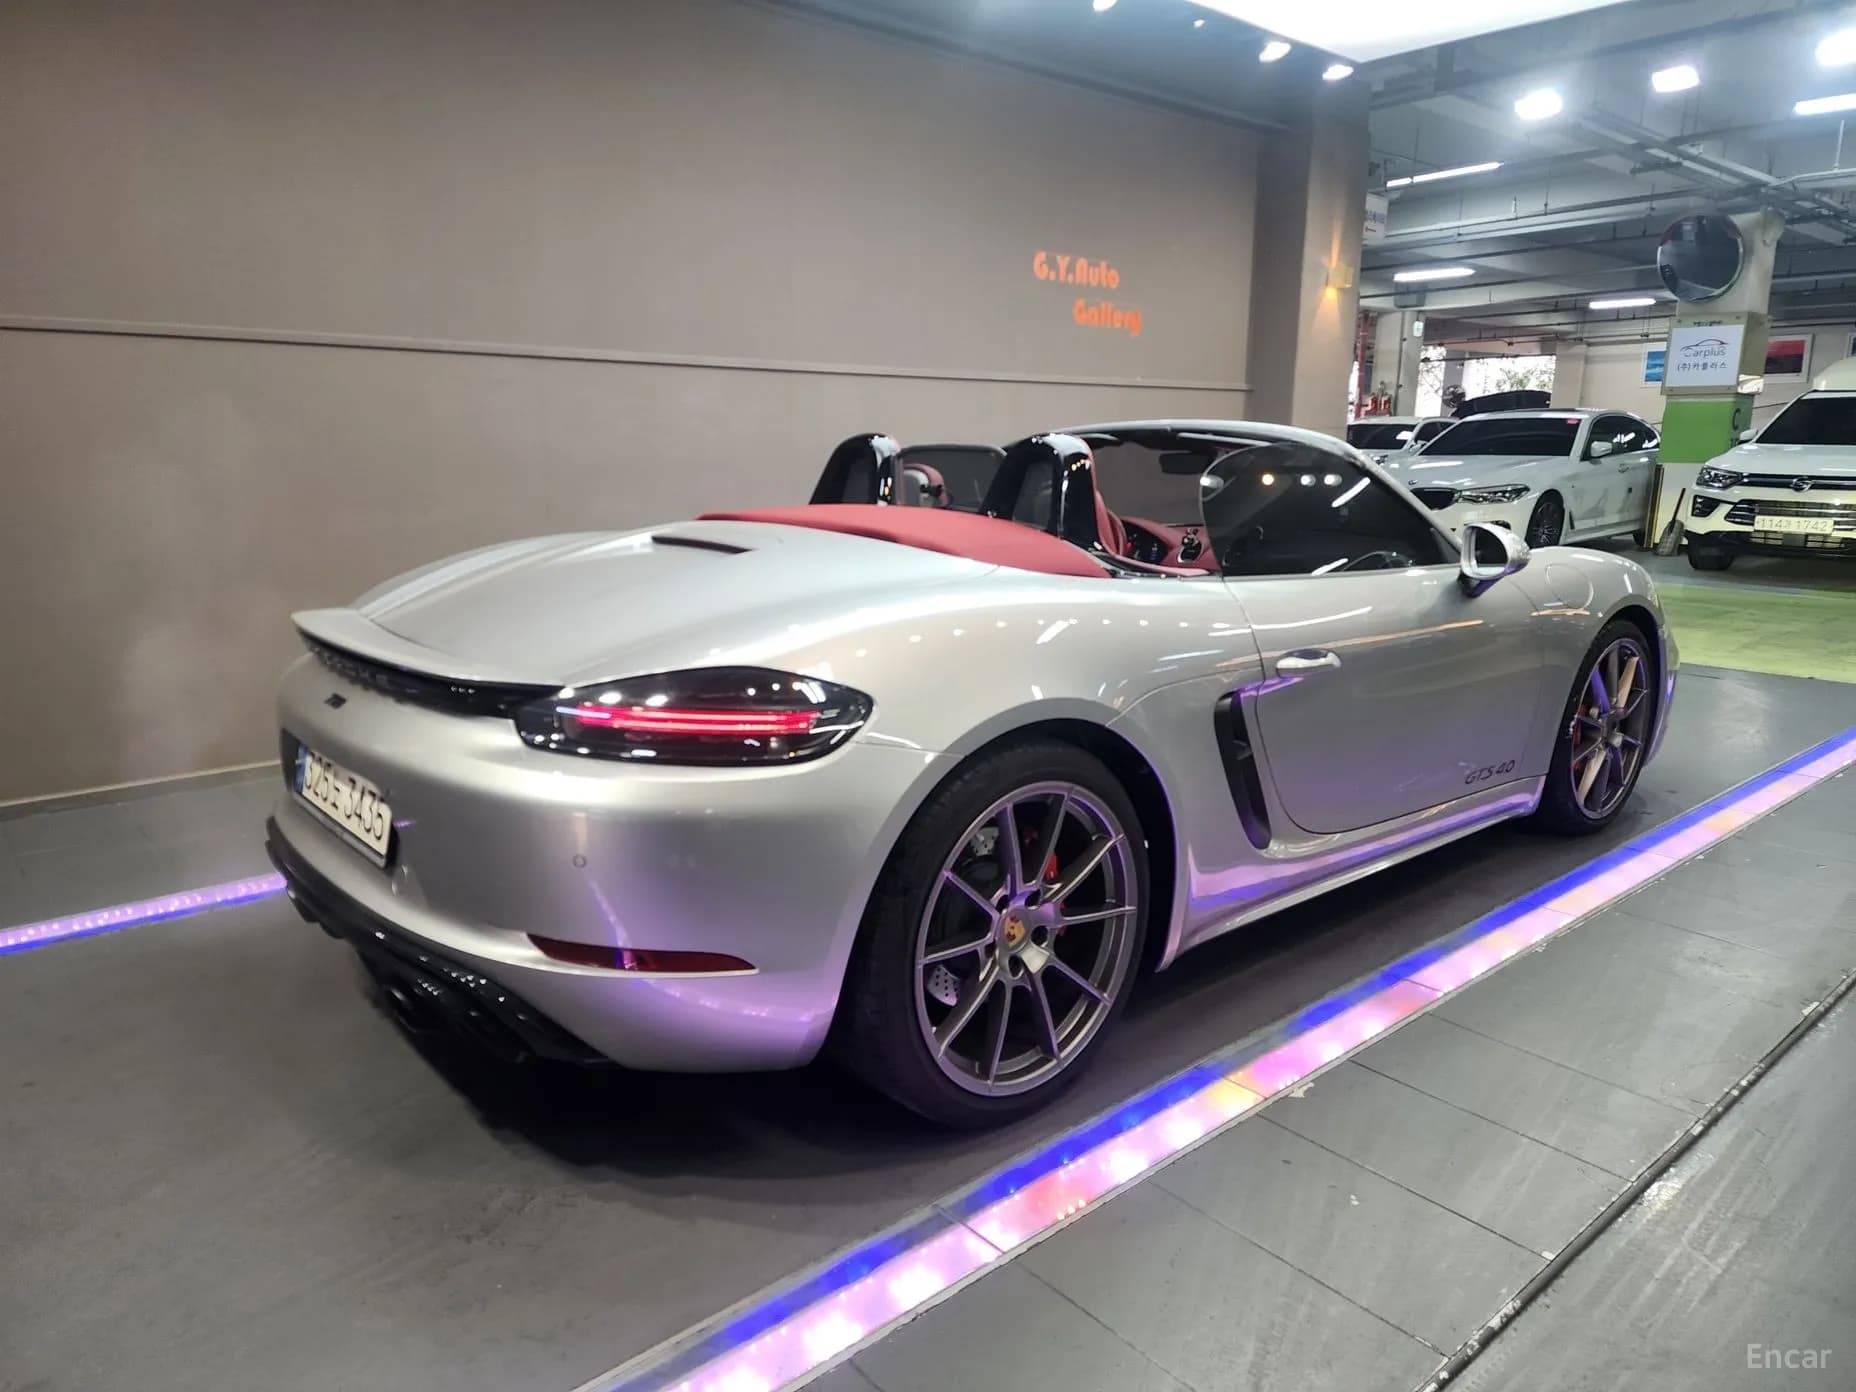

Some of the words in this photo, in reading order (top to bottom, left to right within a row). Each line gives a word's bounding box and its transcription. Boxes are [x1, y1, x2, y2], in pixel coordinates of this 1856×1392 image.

[1033, 251, 1120, 289] G.Y.Auto
[1072, 297, 1142, 337] Gallery
[1683, 345, 1726, 358] Carplus
[1465, 765, 1496, 784] GTS
[343, 776, 384, 841] 3435
